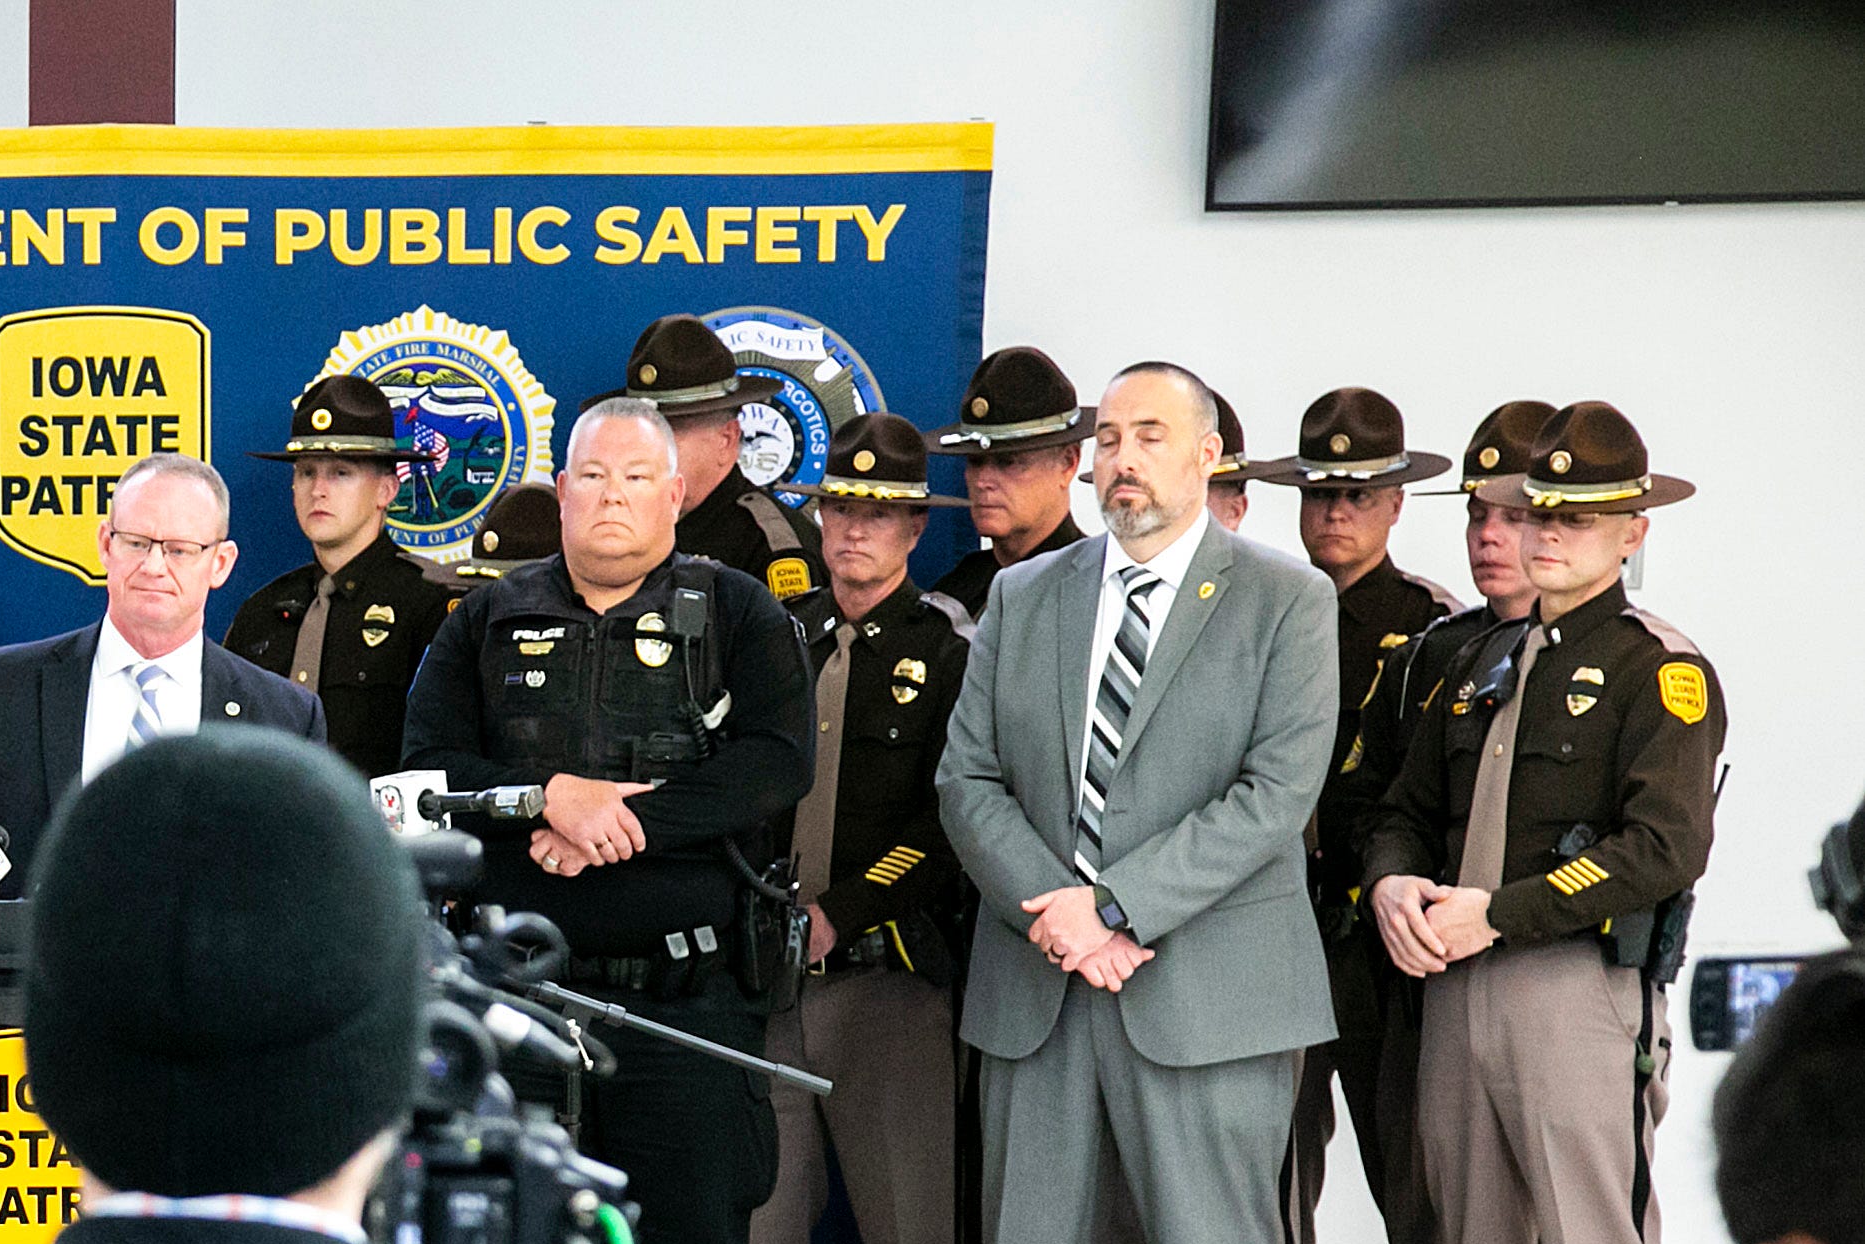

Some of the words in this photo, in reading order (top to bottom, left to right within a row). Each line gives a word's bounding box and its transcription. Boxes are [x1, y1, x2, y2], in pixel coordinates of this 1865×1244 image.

[138, 206, 248, 267] OF
[274, 205, 572, 266] PUBLIC
[594, 203, 907, 266] SAFETY
[757, 331, 816, 352] SAFETY
[32, 356, 168, 398] IOWA
[356, 351, 392, 379] TATE
[394, 342, 431, 360] FIRE
[436, 342, 502, 388] MARSHAL
[19, 415, 181, 457] STATE
[782, 380, 827, 456] RCOTICS
[1, 475, 119, 516] PATR
[512, 627, 566, 641] POLICE
